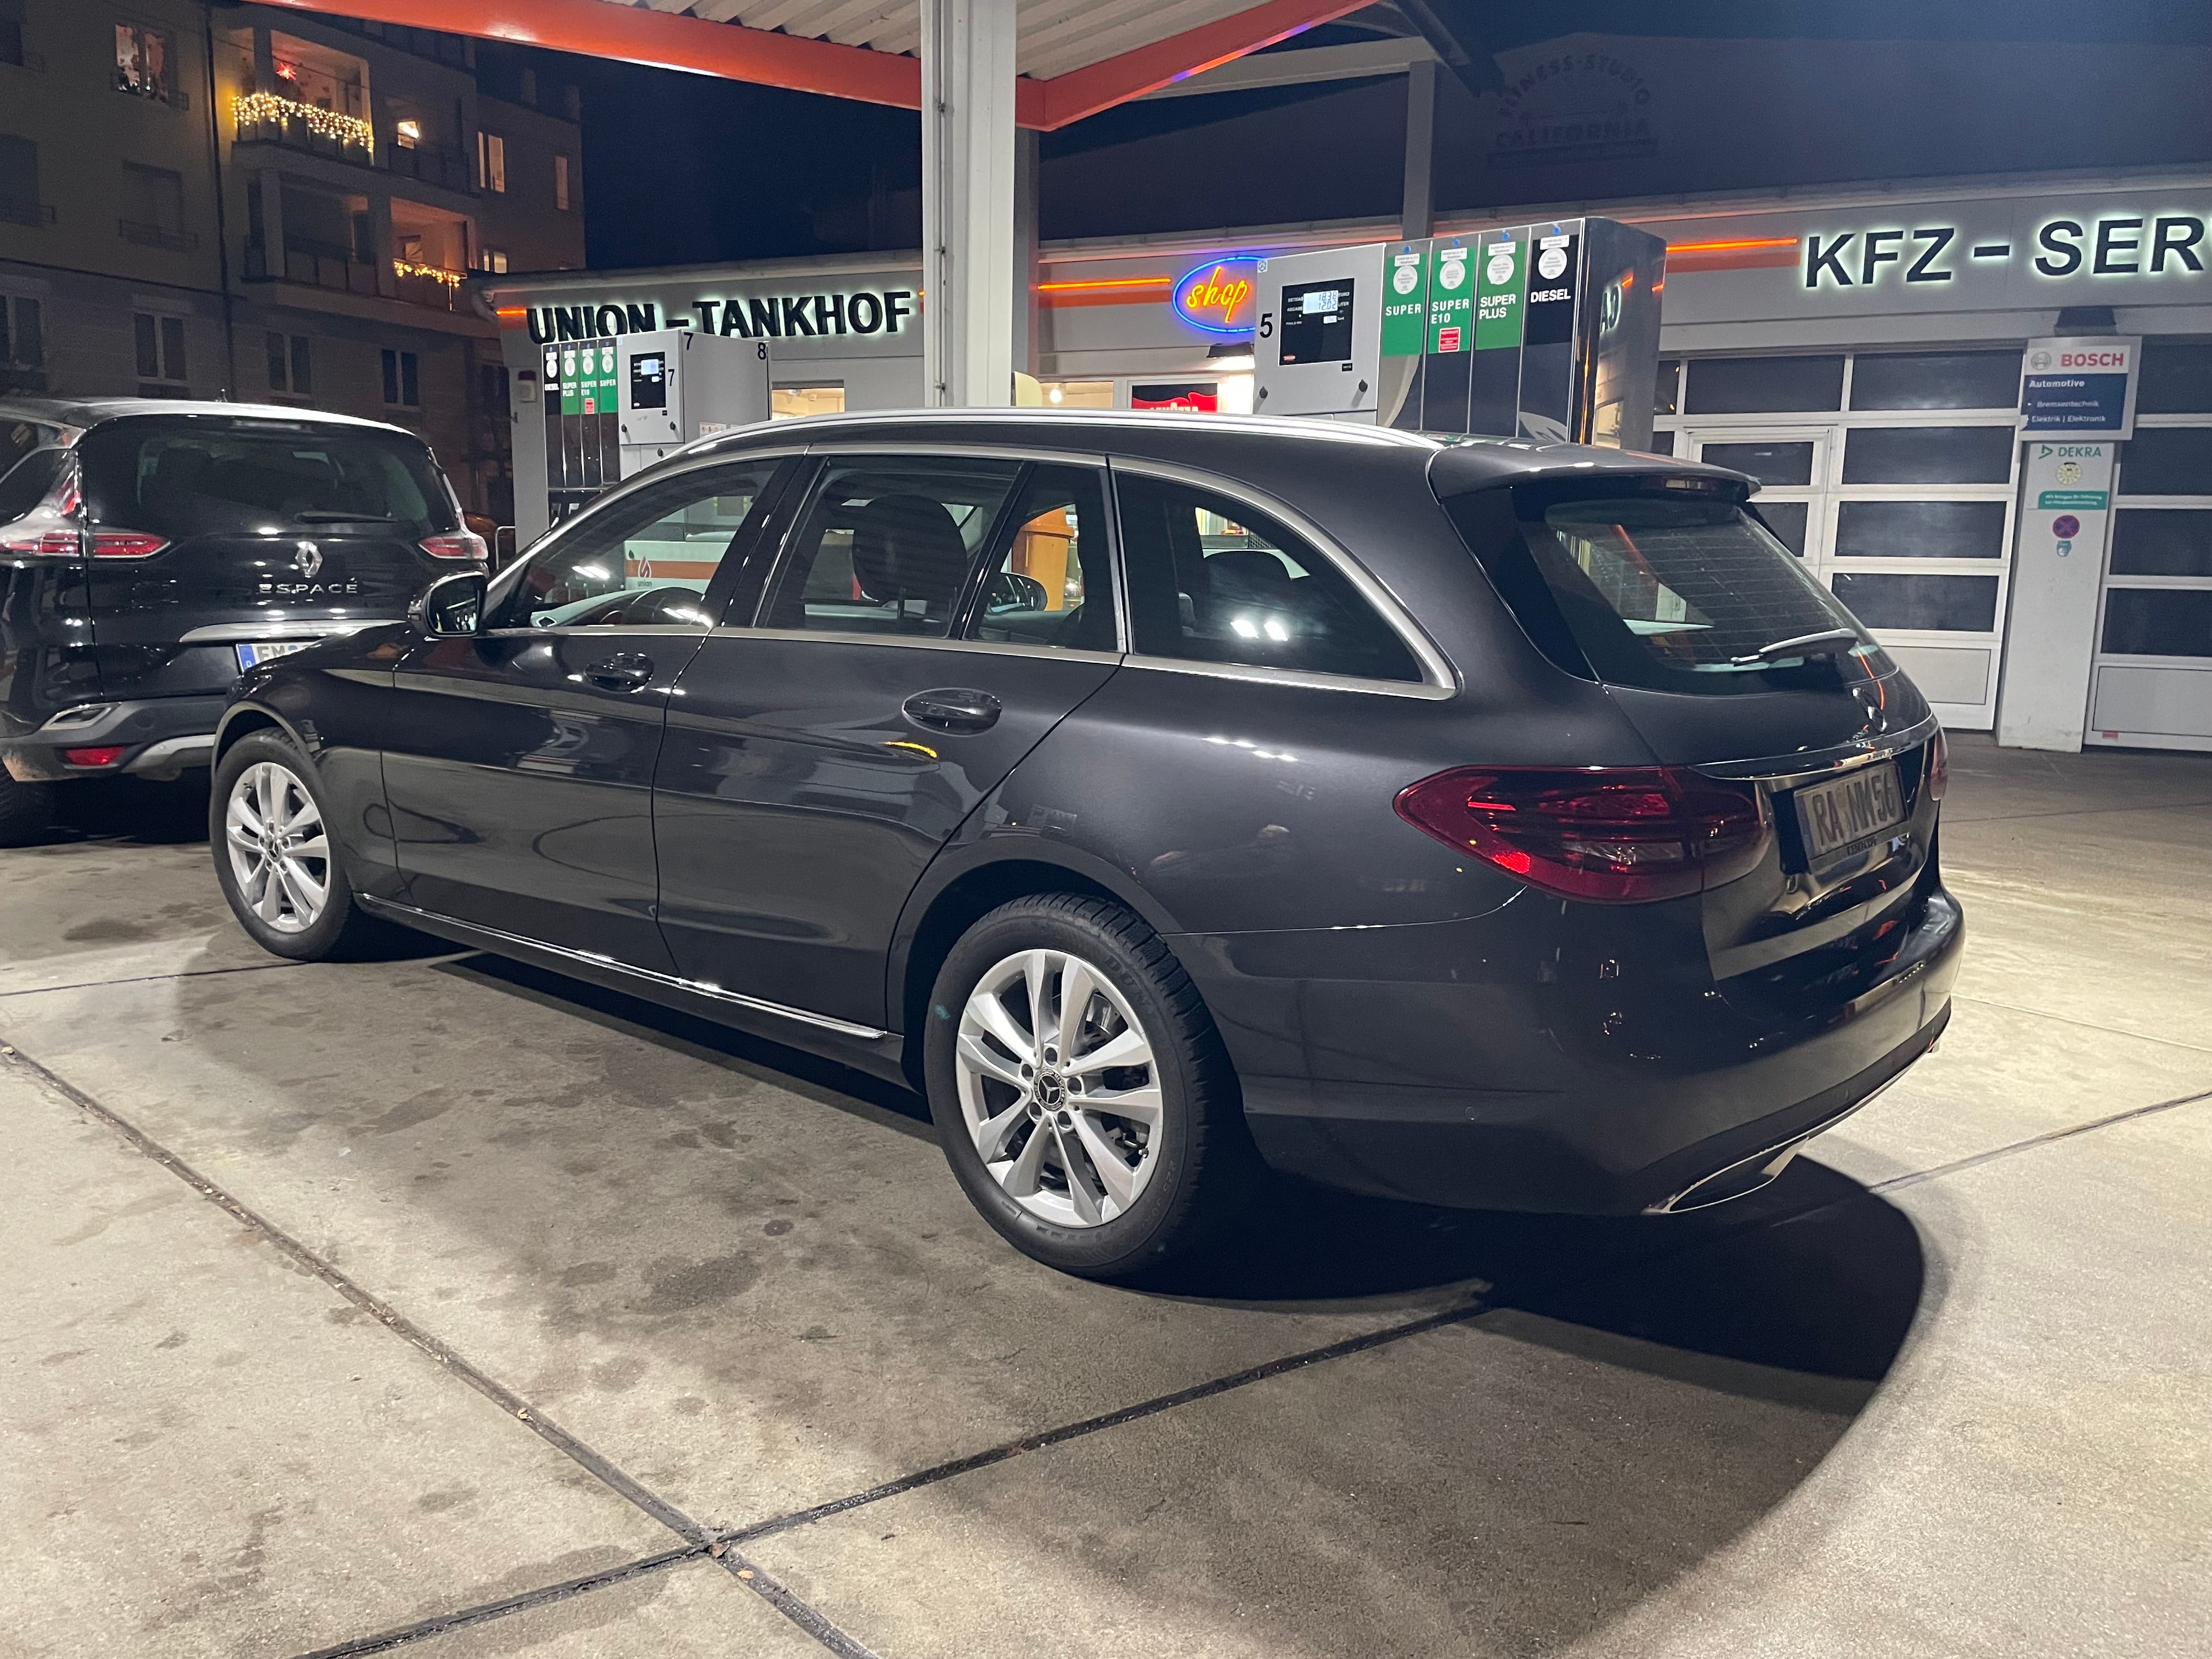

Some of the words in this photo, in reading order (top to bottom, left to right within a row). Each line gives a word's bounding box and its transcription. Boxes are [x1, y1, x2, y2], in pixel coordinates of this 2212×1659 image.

[1805, 228, 1955, 288] KFZ
[2034, 217, 2205, 276] SER
[1186, 266, 1248, 324] shop
[1480, 294, 1516, 307] SUPER
[1530, 289, 1571, 303] DIESEL
[1385, 303, 1421, 317] SUPER
[1432, 298, 1470, 312] SUPER
[526, 303, 657, 345] UNION
[692, 291, 911, 337] TANKHOF
[1431, 313, 1451, 324] E10
[1479, 307, 1507, 319] PLUS
[1260, 312, 1273, 338] 5
[683, 332, 693, 351] 7
[757, 342, 766, 360] 8
[2060, 353, 2124, 367] BOSCH
[600, 379, 616, 387] SUPER
[668, 369, 675, 386] 7
[2029, 379, 2085, 388] Automotive
[2058, 446, 2102, 458] DEKRA
[1812, 791, 1845, 847] RA
